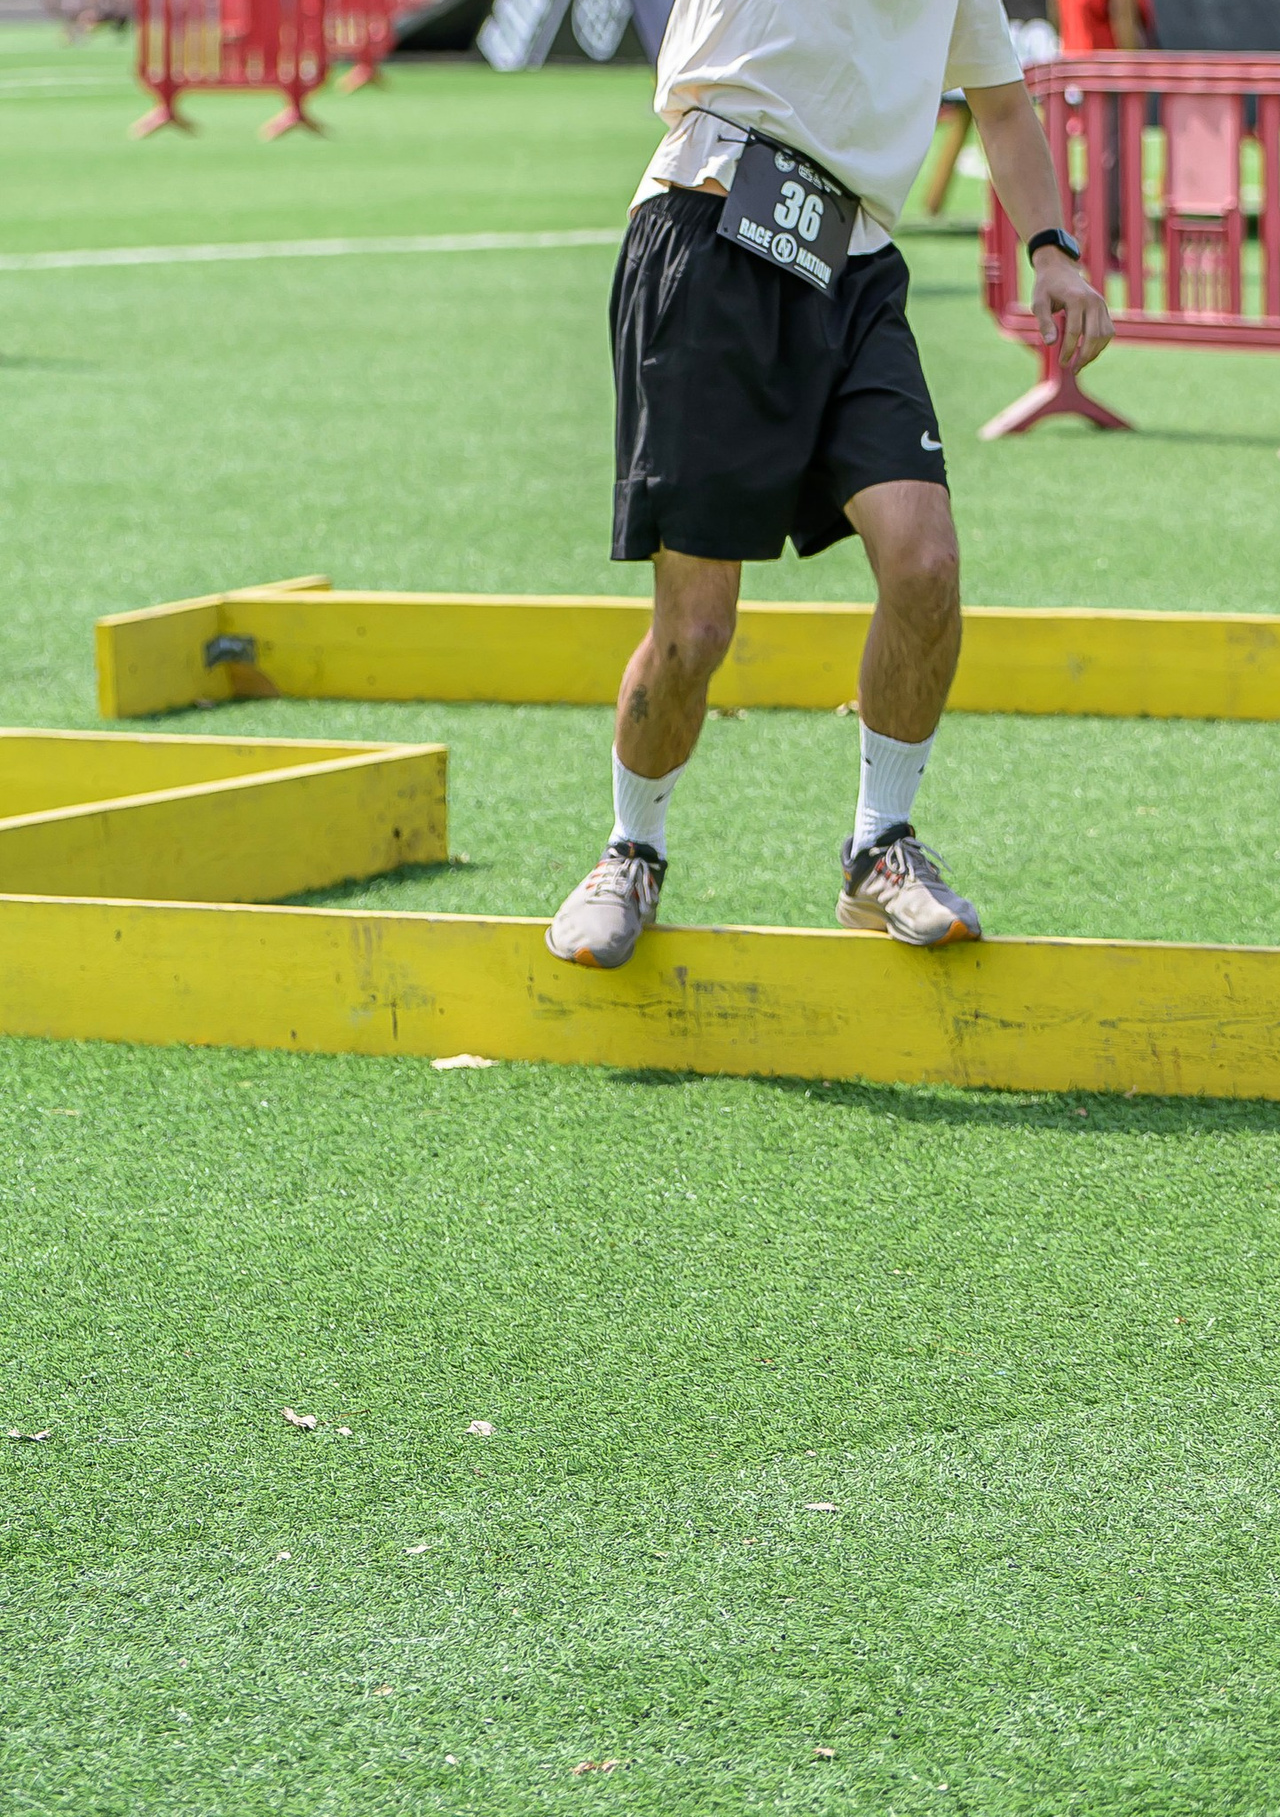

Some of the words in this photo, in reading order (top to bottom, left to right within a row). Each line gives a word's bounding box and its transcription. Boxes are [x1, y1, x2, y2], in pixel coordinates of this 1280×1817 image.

[774, 181, 824, 242] 36
[739, 217, 773, 248] RACE
[796, 247, 832, 284] NATION
